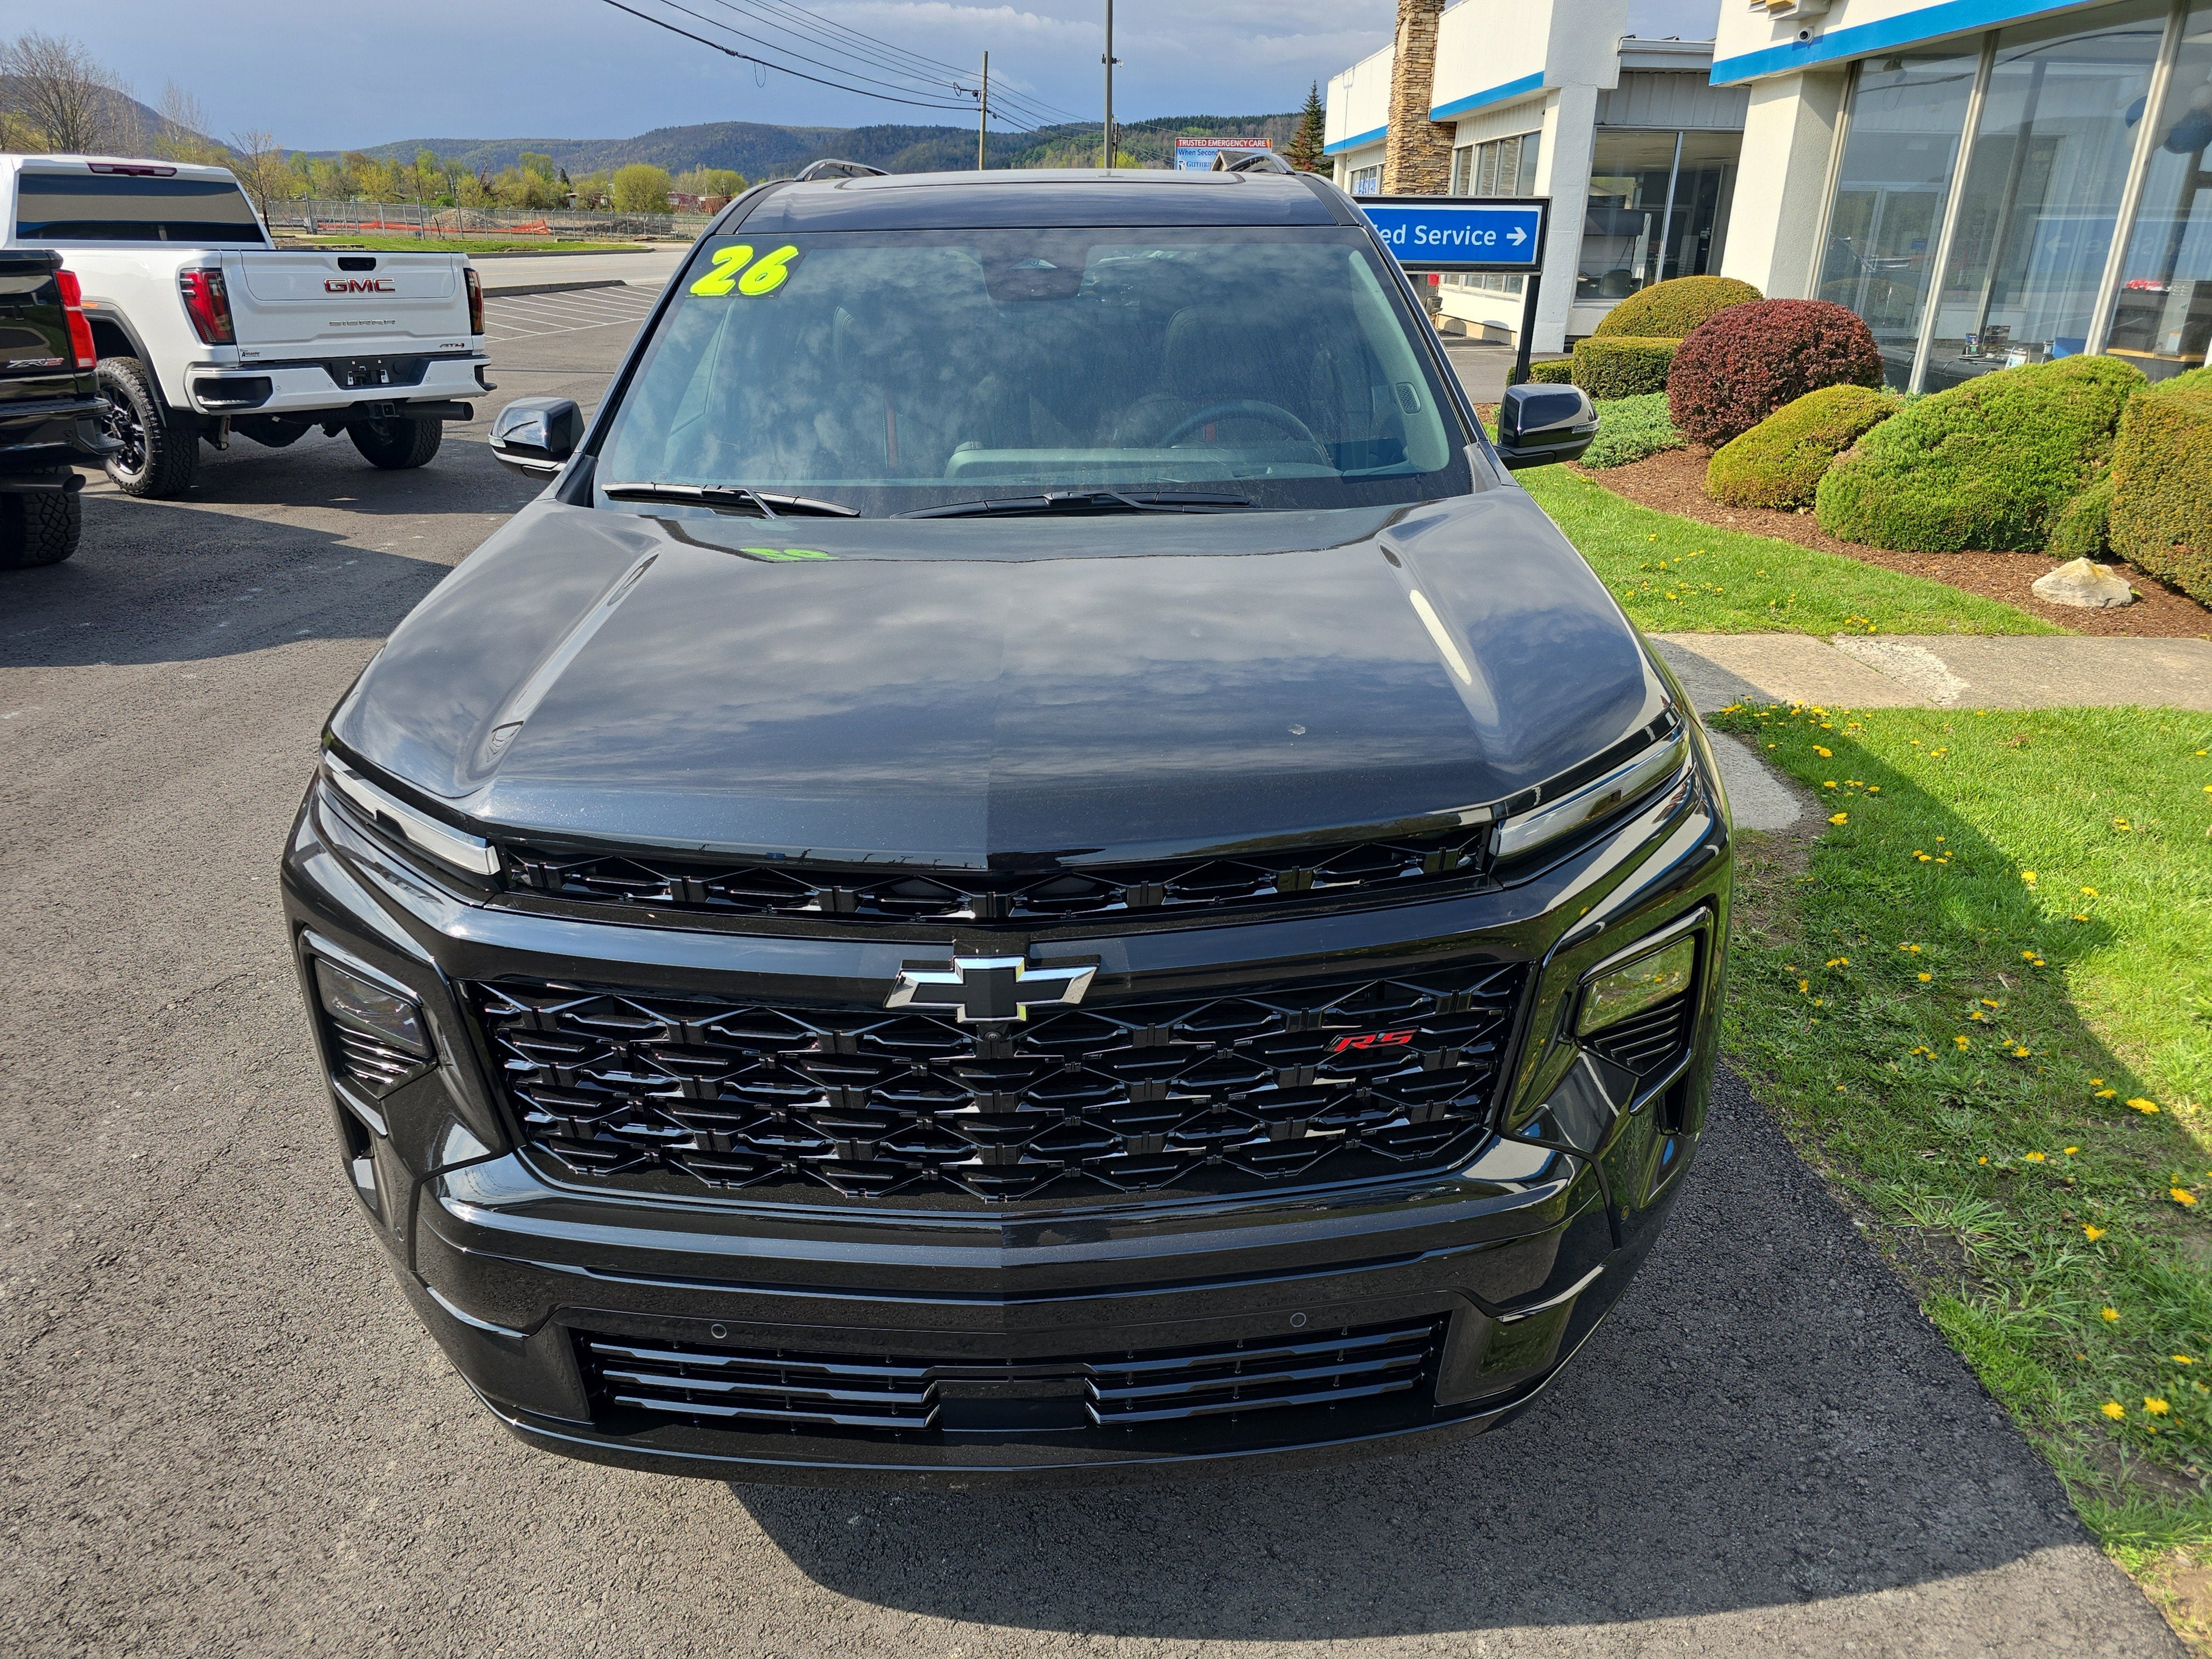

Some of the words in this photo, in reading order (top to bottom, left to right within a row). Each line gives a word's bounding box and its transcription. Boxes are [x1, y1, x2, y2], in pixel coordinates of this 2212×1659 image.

[1179, 139, 1206, 147] TRUSTED
[1413, 224, 1496, 246] Service
[690, 245, 799, 296] 26
[324, 278, 395, 293] GMC
[7, 357, 65, 369] ZR2
[1327, 1027, 1419, 1052] RS
